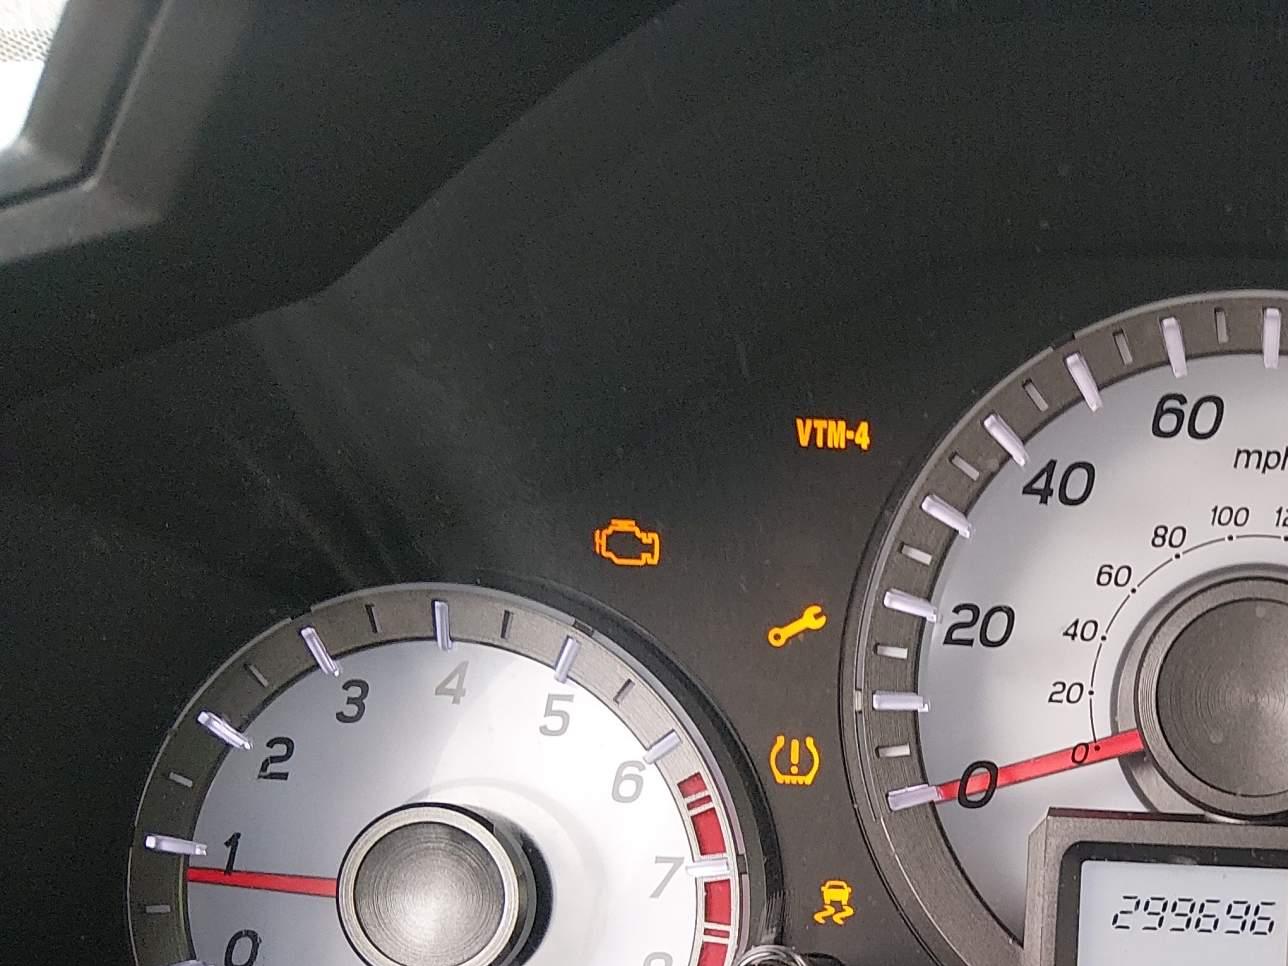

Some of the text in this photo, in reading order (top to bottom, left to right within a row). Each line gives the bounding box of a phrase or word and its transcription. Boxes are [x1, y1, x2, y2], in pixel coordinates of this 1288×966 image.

[796, 418, 870, 450] VTM-4
[1151, 393, 1225, 439] 60
[1022, 460, 1096, 506] 40
[1209, 505, 1249, 528] 100
[1150, 526, 1187, 550] 80
[1095, 564, 1133, 588] 60
[943, 604, 1015, 648] 20
[1062, 618, 1100, 643] 40
[336, 679, 370, 723] 3
[435, 661, 468, 705] 4
[1048, 681, 1084, 704] 20
[540, 695, 571, 736] 5
[258, 737, 295, 780] 2
[1070, 741, 1090, 765] 0
[611, 761, 645, 803] 6
[957, 760, 1000, 809] 0
[222, 832, 241, 875] 1
[652, 857, 684, 899] 7
[1112, 895, 1276, 936] 299696
